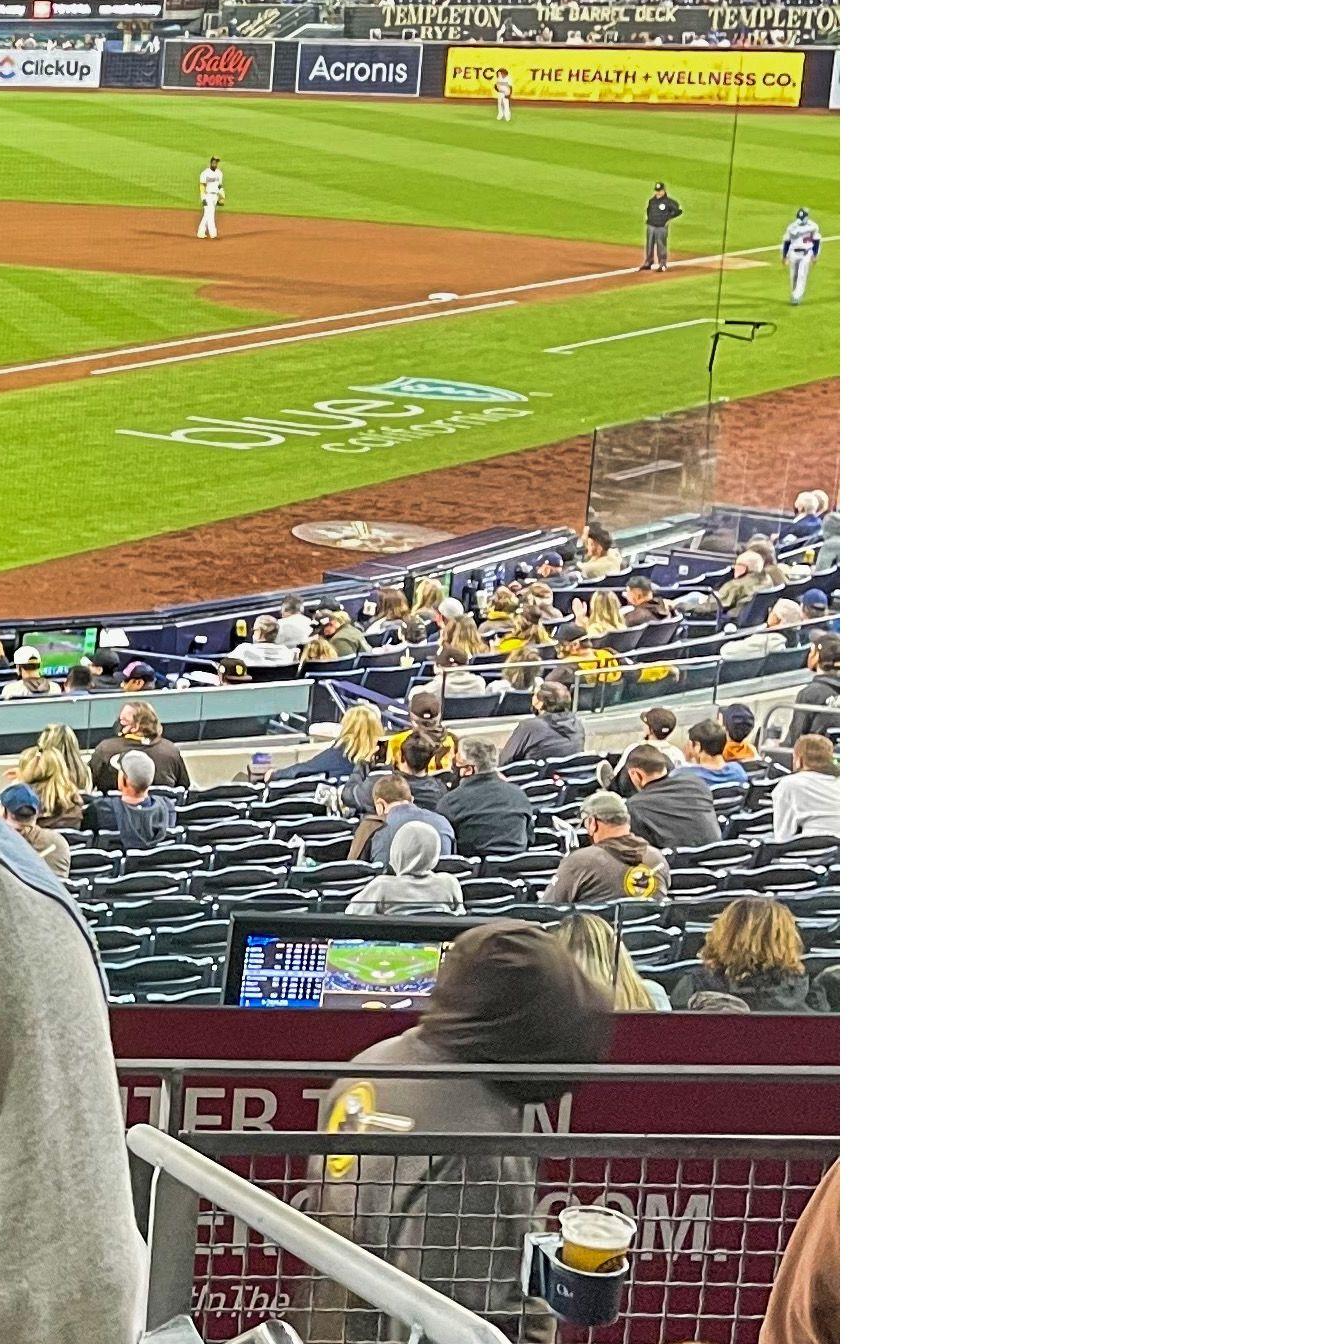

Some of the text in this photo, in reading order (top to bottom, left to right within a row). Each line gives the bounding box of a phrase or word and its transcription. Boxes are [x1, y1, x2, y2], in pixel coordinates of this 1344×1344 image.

[381, 6, 503, 28] TEMPLETON
[537, 5, 566, 22] THE
[637, 6, 678, 23] DECK
[22, 59, 91, 80] ClickUp
[182, 44, 255, 81] Bally
[308, 55, 408, 84] Acronis
[195, 74, 235, 87] SPORTS
[529, 68, 563, 83] THE
[568, 68, 637, 84] HEALTH
[657, 70, 756, 87] WELLNESS
[762, 72, 797, 88] CO.
[115, 398, 425, 450] blue
